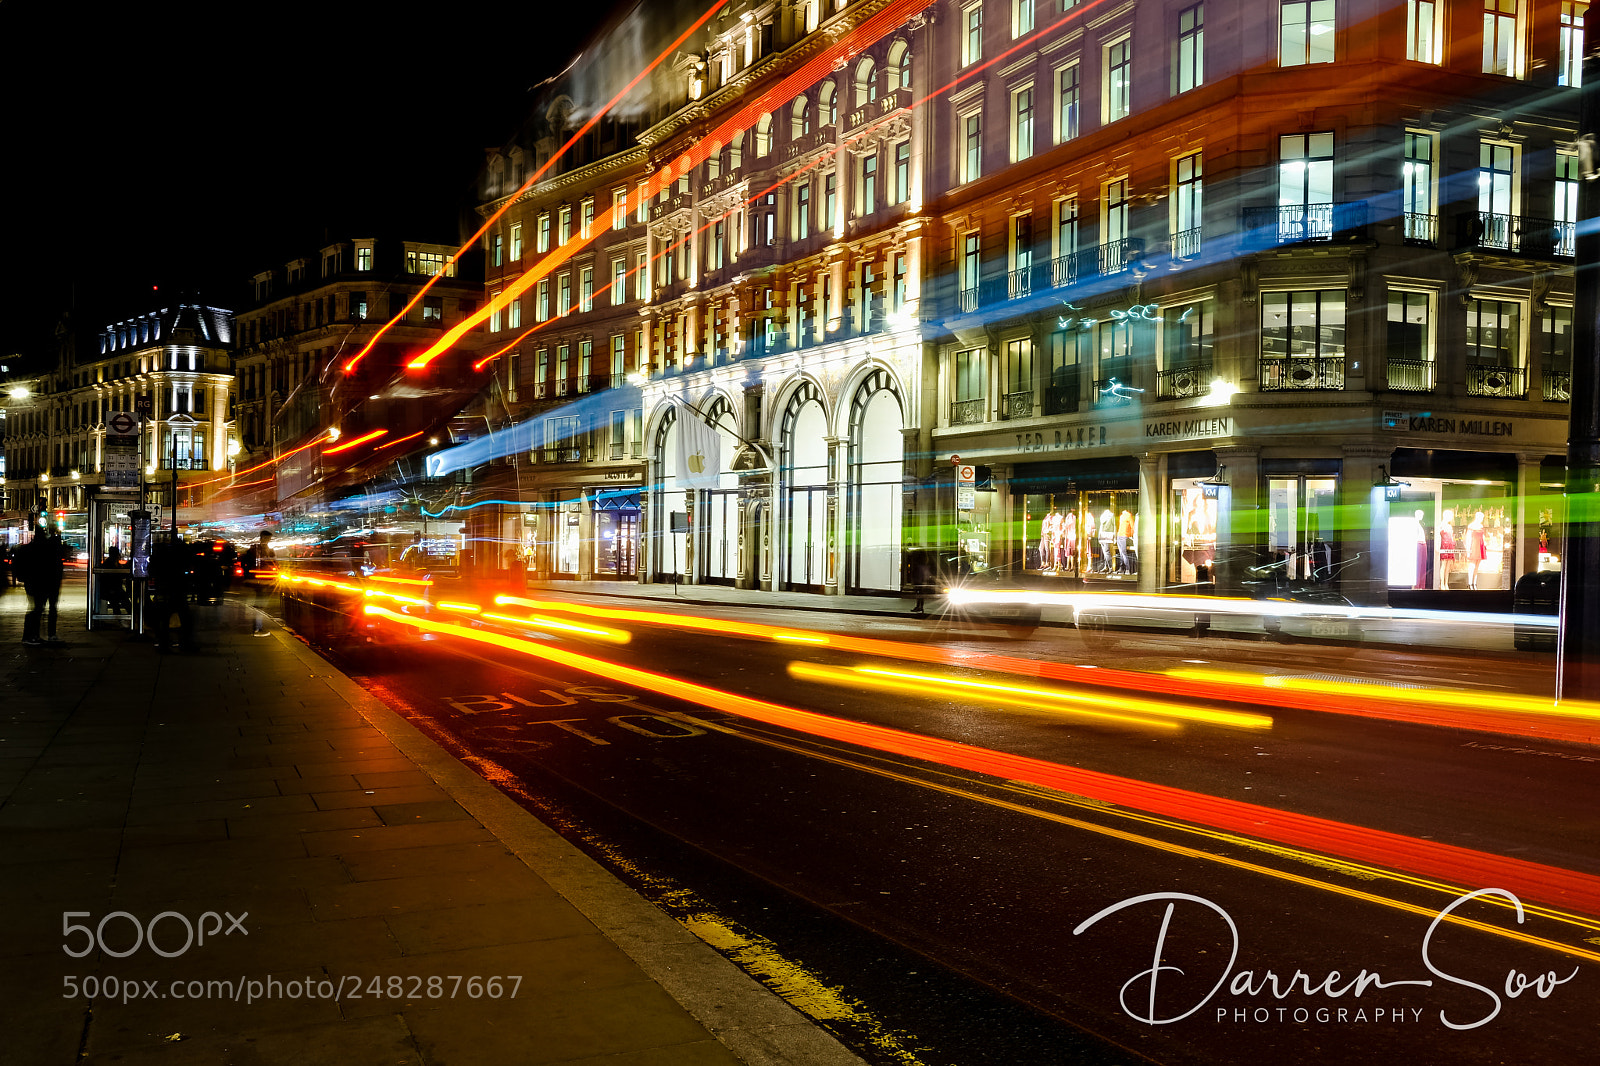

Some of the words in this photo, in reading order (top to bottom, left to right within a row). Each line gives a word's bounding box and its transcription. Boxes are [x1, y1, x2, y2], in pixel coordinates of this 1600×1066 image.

[137, 400, 151, 408] RG
[1146, 421, 1181, 437] KAREN
[1184, 416, 1228, 436] MILLEN
[1409, 416, 1456, 433] KAREN
[1459, 419, 1513, 437] MILLEN
[1015, 432, 1044, 451] TED
[1054, 425, 1107, 449] BAKER
[426, 454, 447, 477] 12
[1205, 487, 1217, 497] KM
[439, 685, 640, 715] BUS
